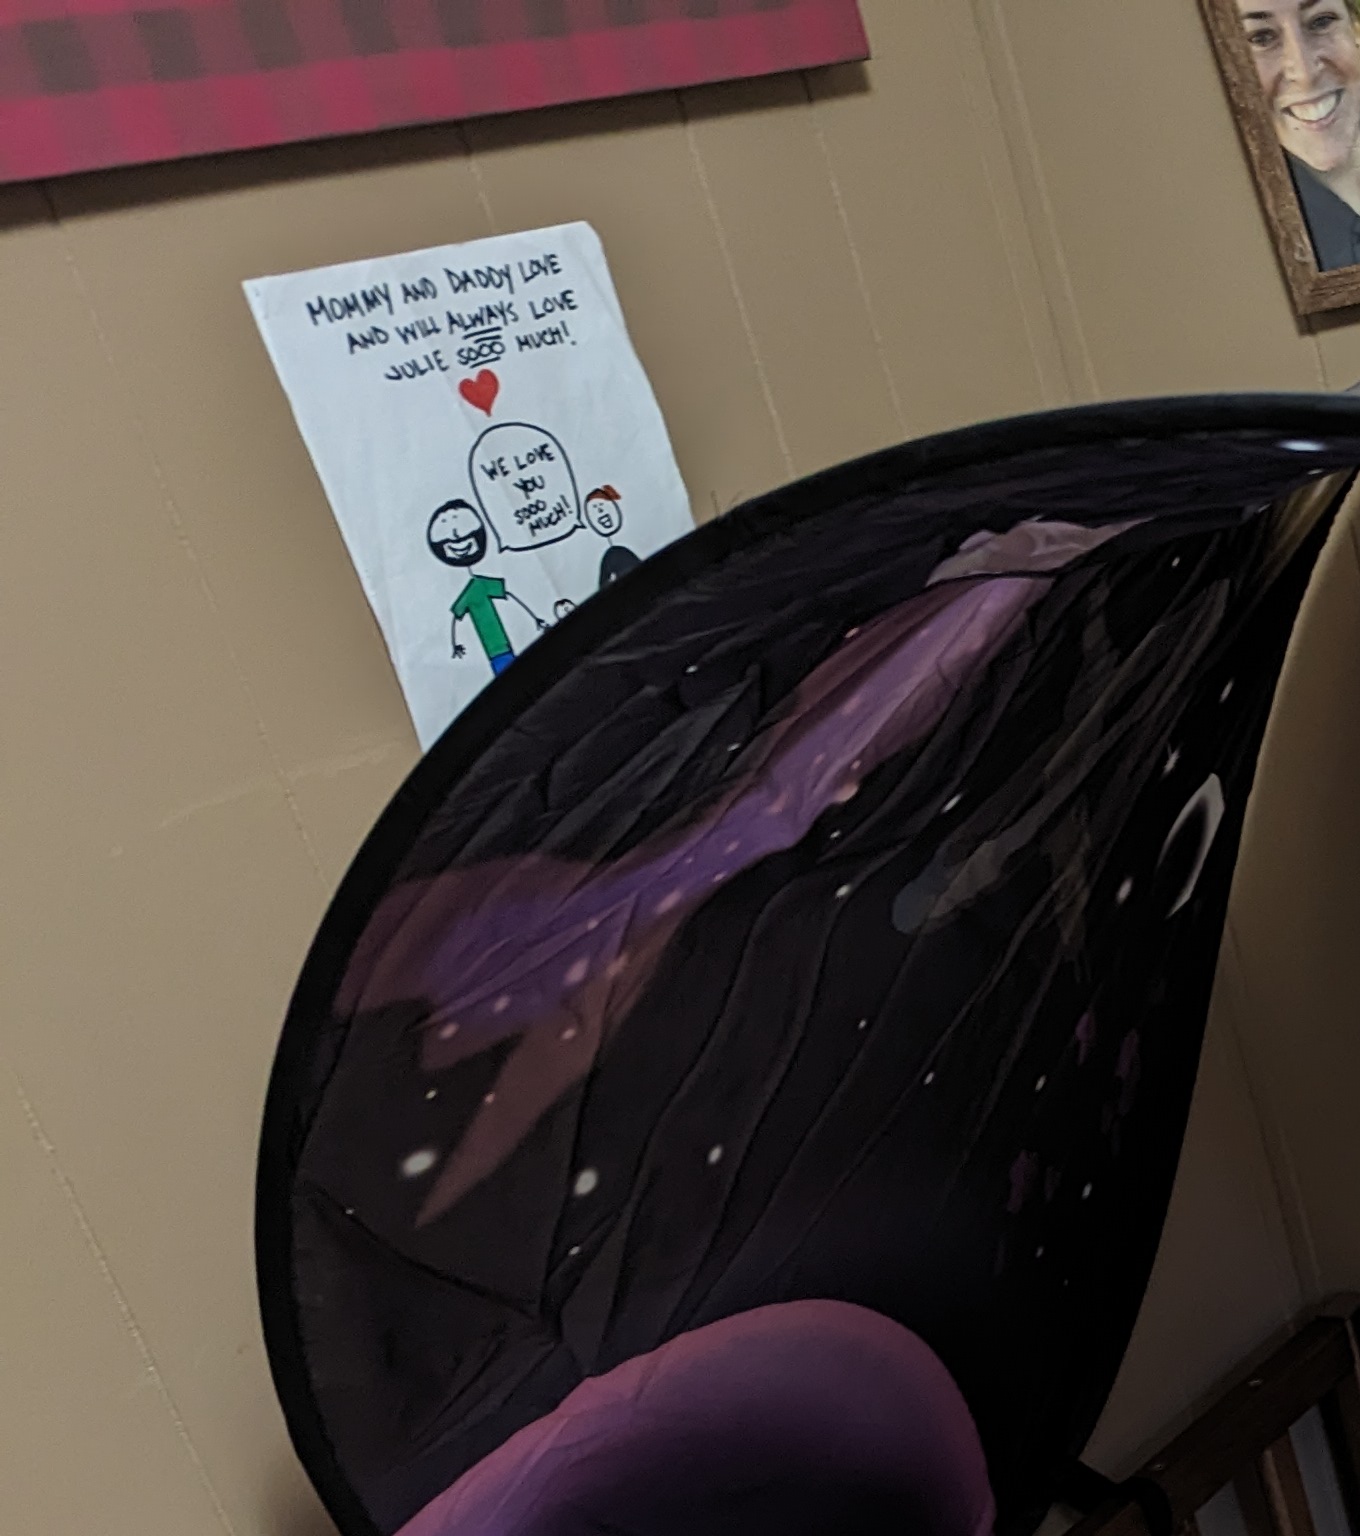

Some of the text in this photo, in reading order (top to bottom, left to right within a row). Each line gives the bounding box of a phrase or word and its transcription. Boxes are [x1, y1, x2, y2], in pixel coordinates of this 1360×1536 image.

[306, 254, 562, 326] MOMMY AND DADDY LOVE
[346, 289, 578, 355] AND WILL ALWAYS LOVE
[384, 350, 449, 381] JULIE
[515, 321, 577, 353] MUCH!
[480, 443, 555, 481] WE LOVE
[512, 475, 545, 500] YOU
[528, 494, 573, 537] MUCH!
